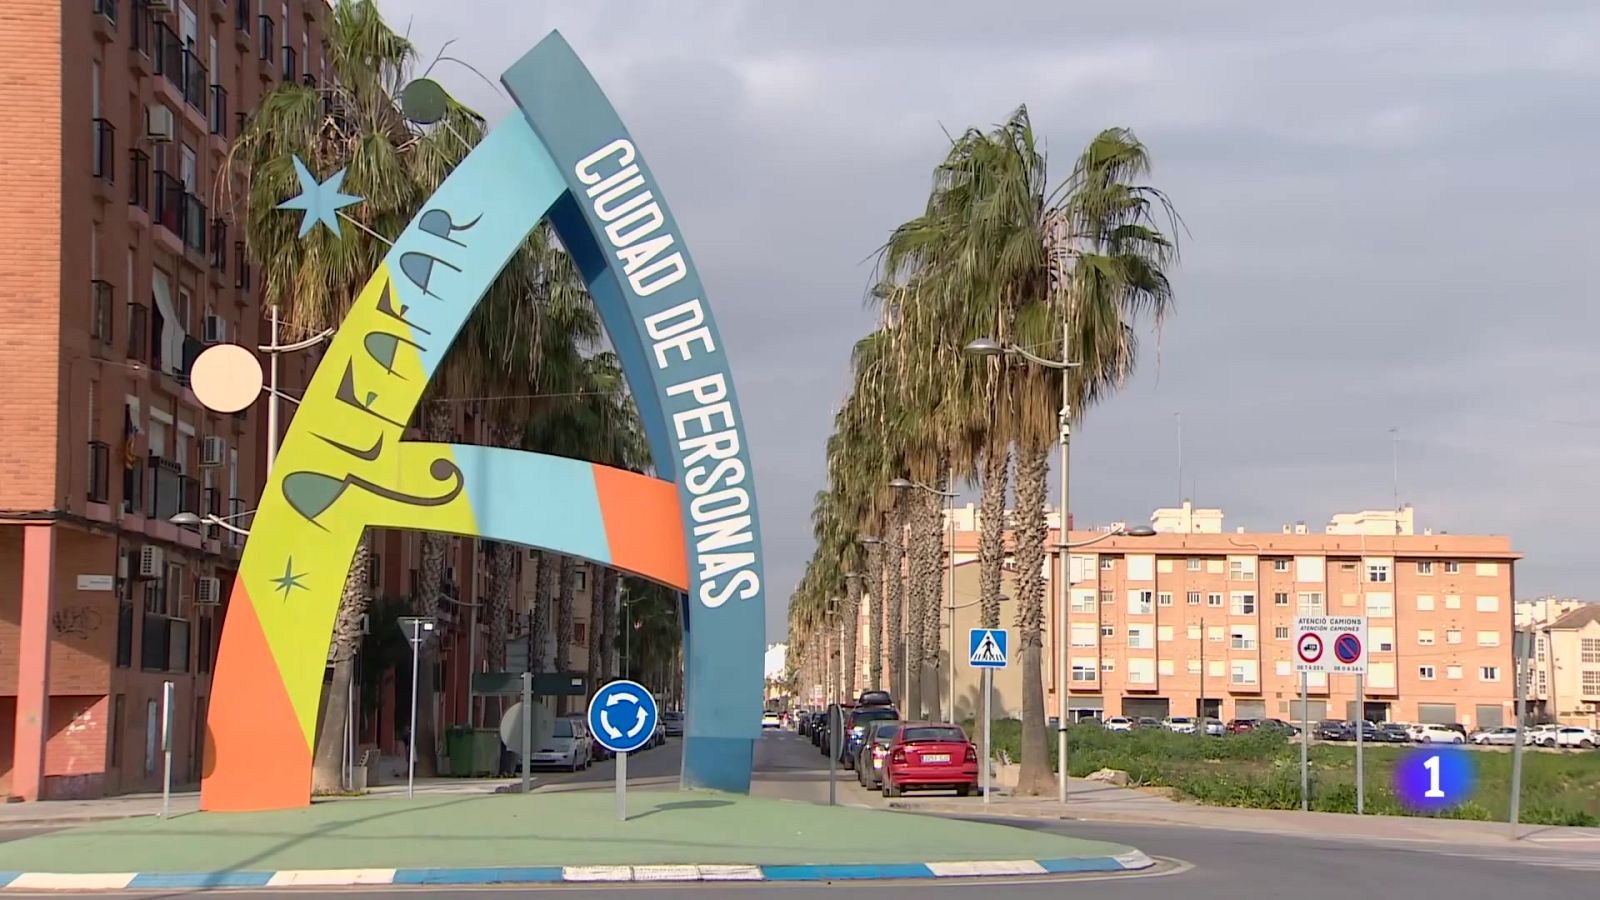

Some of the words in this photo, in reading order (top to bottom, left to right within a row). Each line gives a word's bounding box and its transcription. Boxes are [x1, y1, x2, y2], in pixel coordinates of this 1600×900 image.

[575, 139, 687, 297] CIUDAD
[282, 209, 484, 533] ALFAFAR
[644, 299, 716, 369] DE
[666, 373, 760, 608] PERSONAS
[1298, 617, 1327, 625] ATENCIÓ
